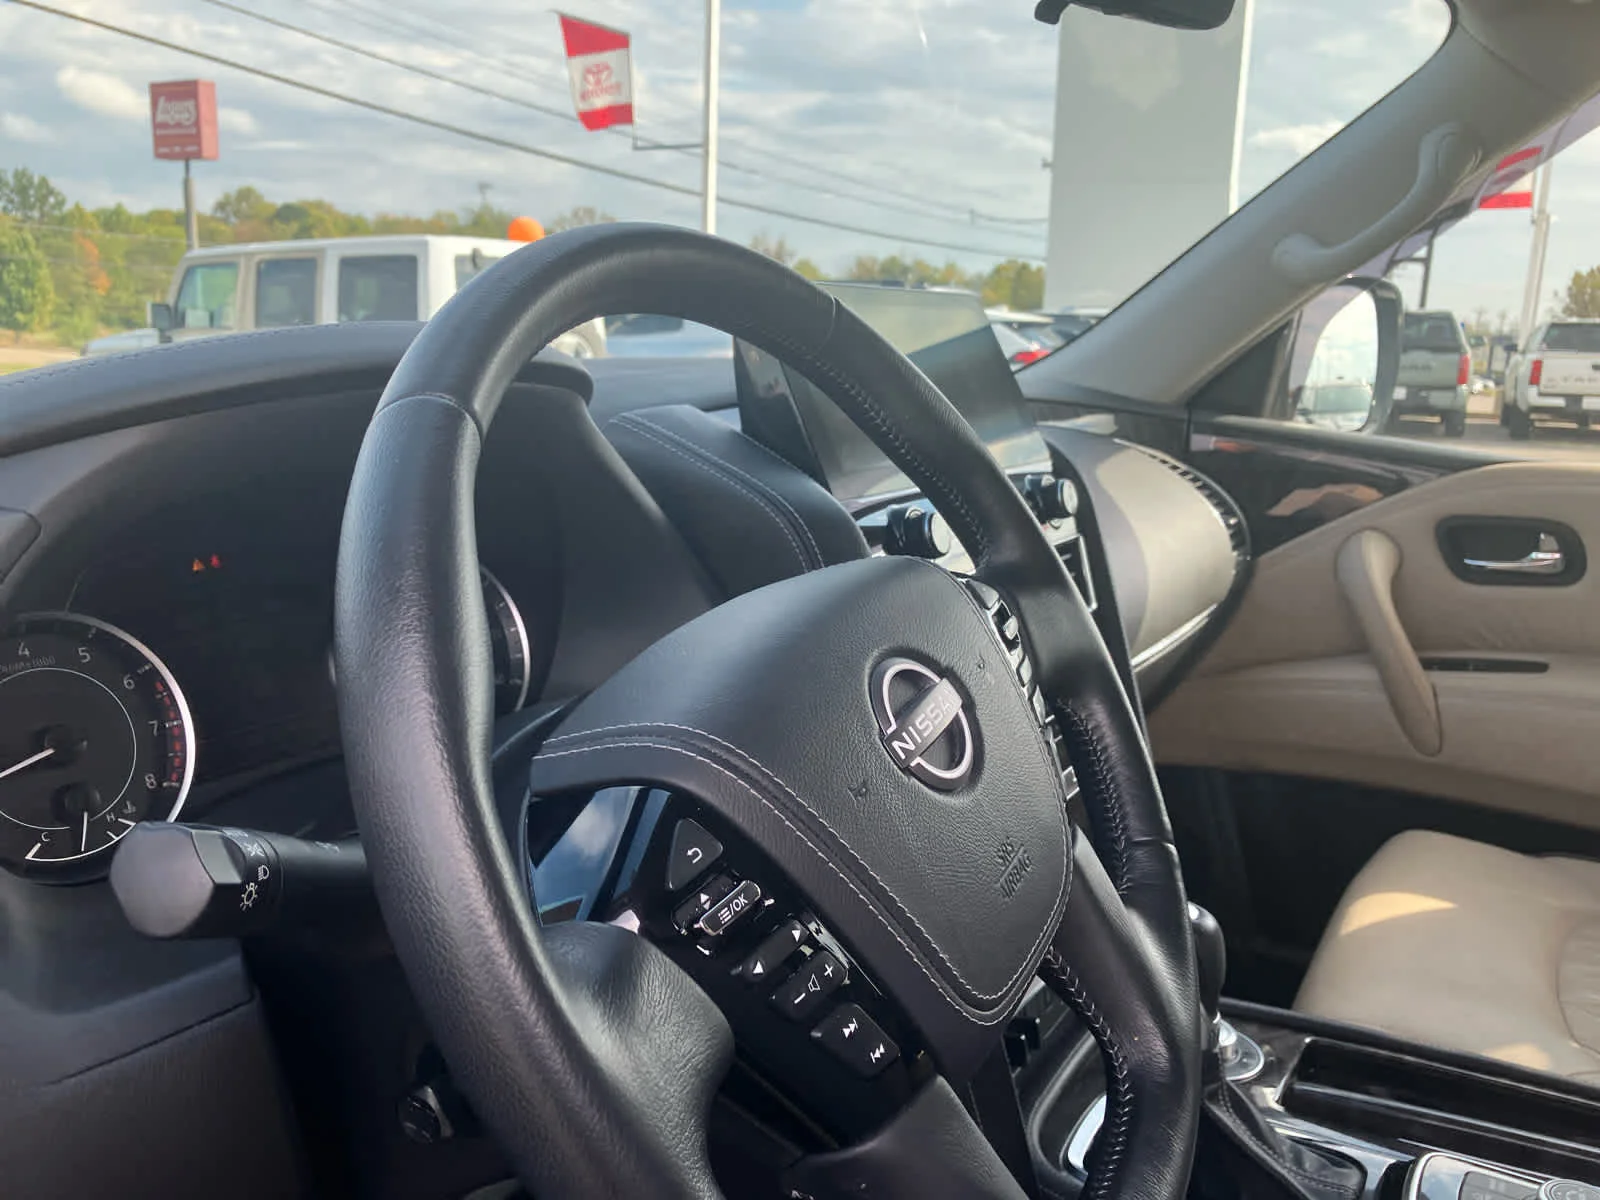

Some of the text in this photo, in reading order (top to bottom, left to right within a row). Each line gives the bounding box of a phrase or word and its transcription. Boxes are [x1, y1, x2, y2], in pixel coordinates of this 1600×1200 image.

[18, 642, 30, 657] 4
[79, 648, 91, 663] 5
[123, 674, 135, 690] 6
[148, 720, 158, 737] 7
[144, 773, 156, 789] 8
[106, 812, 116, 823] H
[41, 831, 51, 842] C
